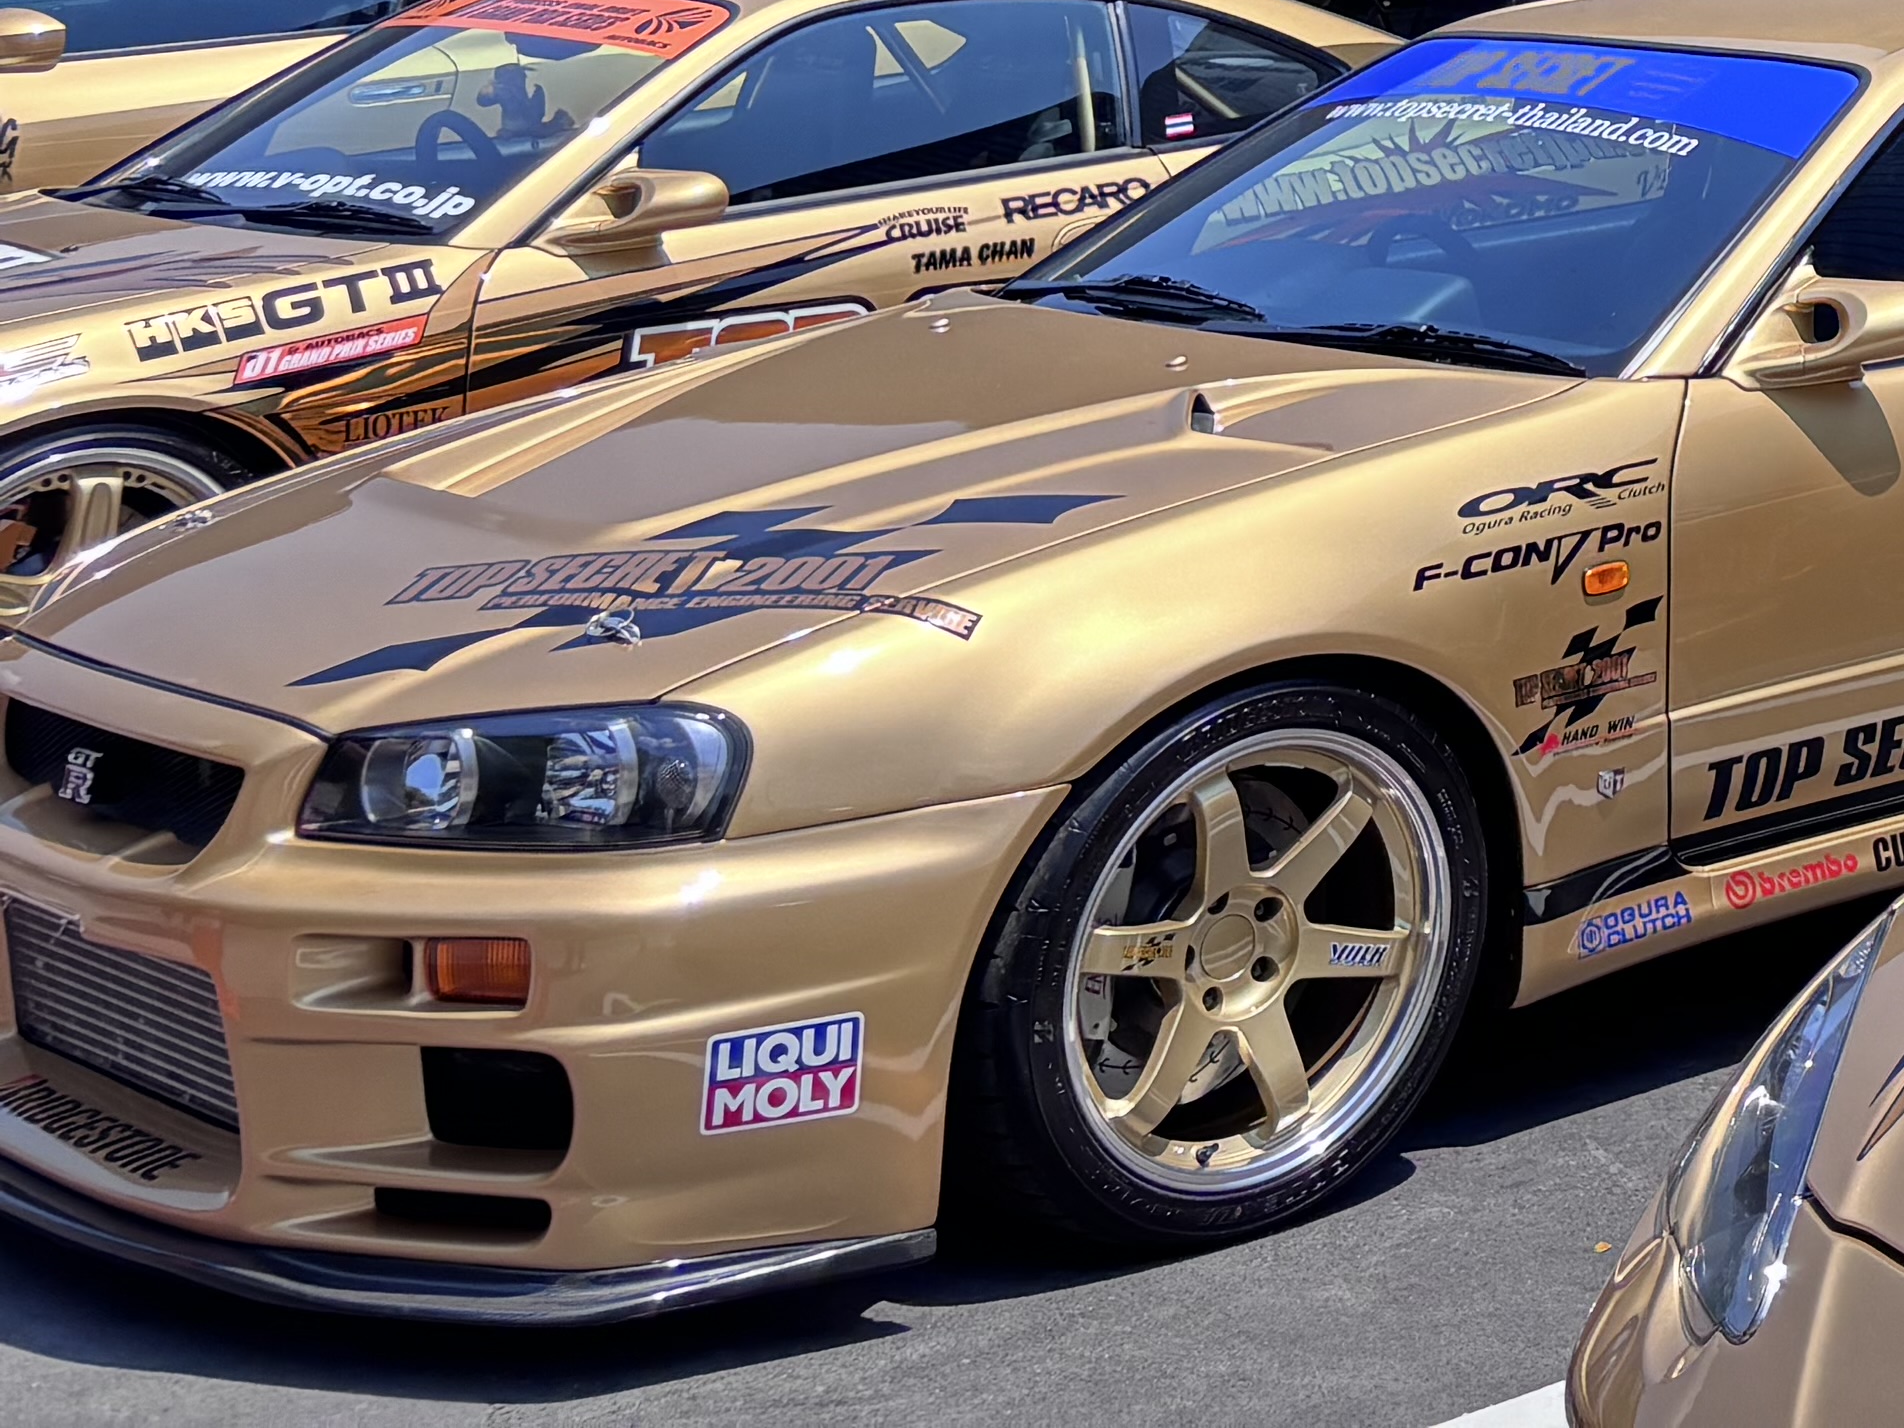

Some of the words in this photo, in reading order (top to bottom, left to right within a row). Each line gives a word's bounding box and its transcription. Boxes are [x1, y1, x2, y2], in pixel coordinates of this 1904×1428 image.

[1326, 96, 1699, 158] www.topsecret-thailand.com
[189, 167, 477, 220] www.v-opt.co.jp
[999, 177, 1152, 225] RECARO
[885, 214, 968, 242] CRUISE
[911, 245, 973, 275] TAMA
[977, 236, 1036, 266] CHAN
[124, 295, 266, 362] HKS
[279, 345, 334, 373] GRAND
[366, 326, 418, 356] SERIES
[1457, 457, 1659, 519] ORC
[1462, 514, 1514, 536] Ogura
[1518, 502, 1574, 524] Racing
[1616, 481, 1666, 501] Clutch
[1596, 519, 1663, 553] Pro
[384, 558, 520, 606] TOP
[505, 549, 724, 594] SECRET
[722, 553, 899, 594] 2001
[690, 593, 861, 610] ENGINEERING
[1561, 723, 1600, 746] HAND
[1606, 714, 1637, 734] WIN
[1703, 749, 1828, 823] TOP
[1759, 852, 1860, 899] brembo
[1603, 890, 1689, 929] OGURA
[1607, 906, 1693, 949] CLUTCH
[714, 1019, 854, 1084] LIQUI
[710, 1064, 855, 1127] MOLY
